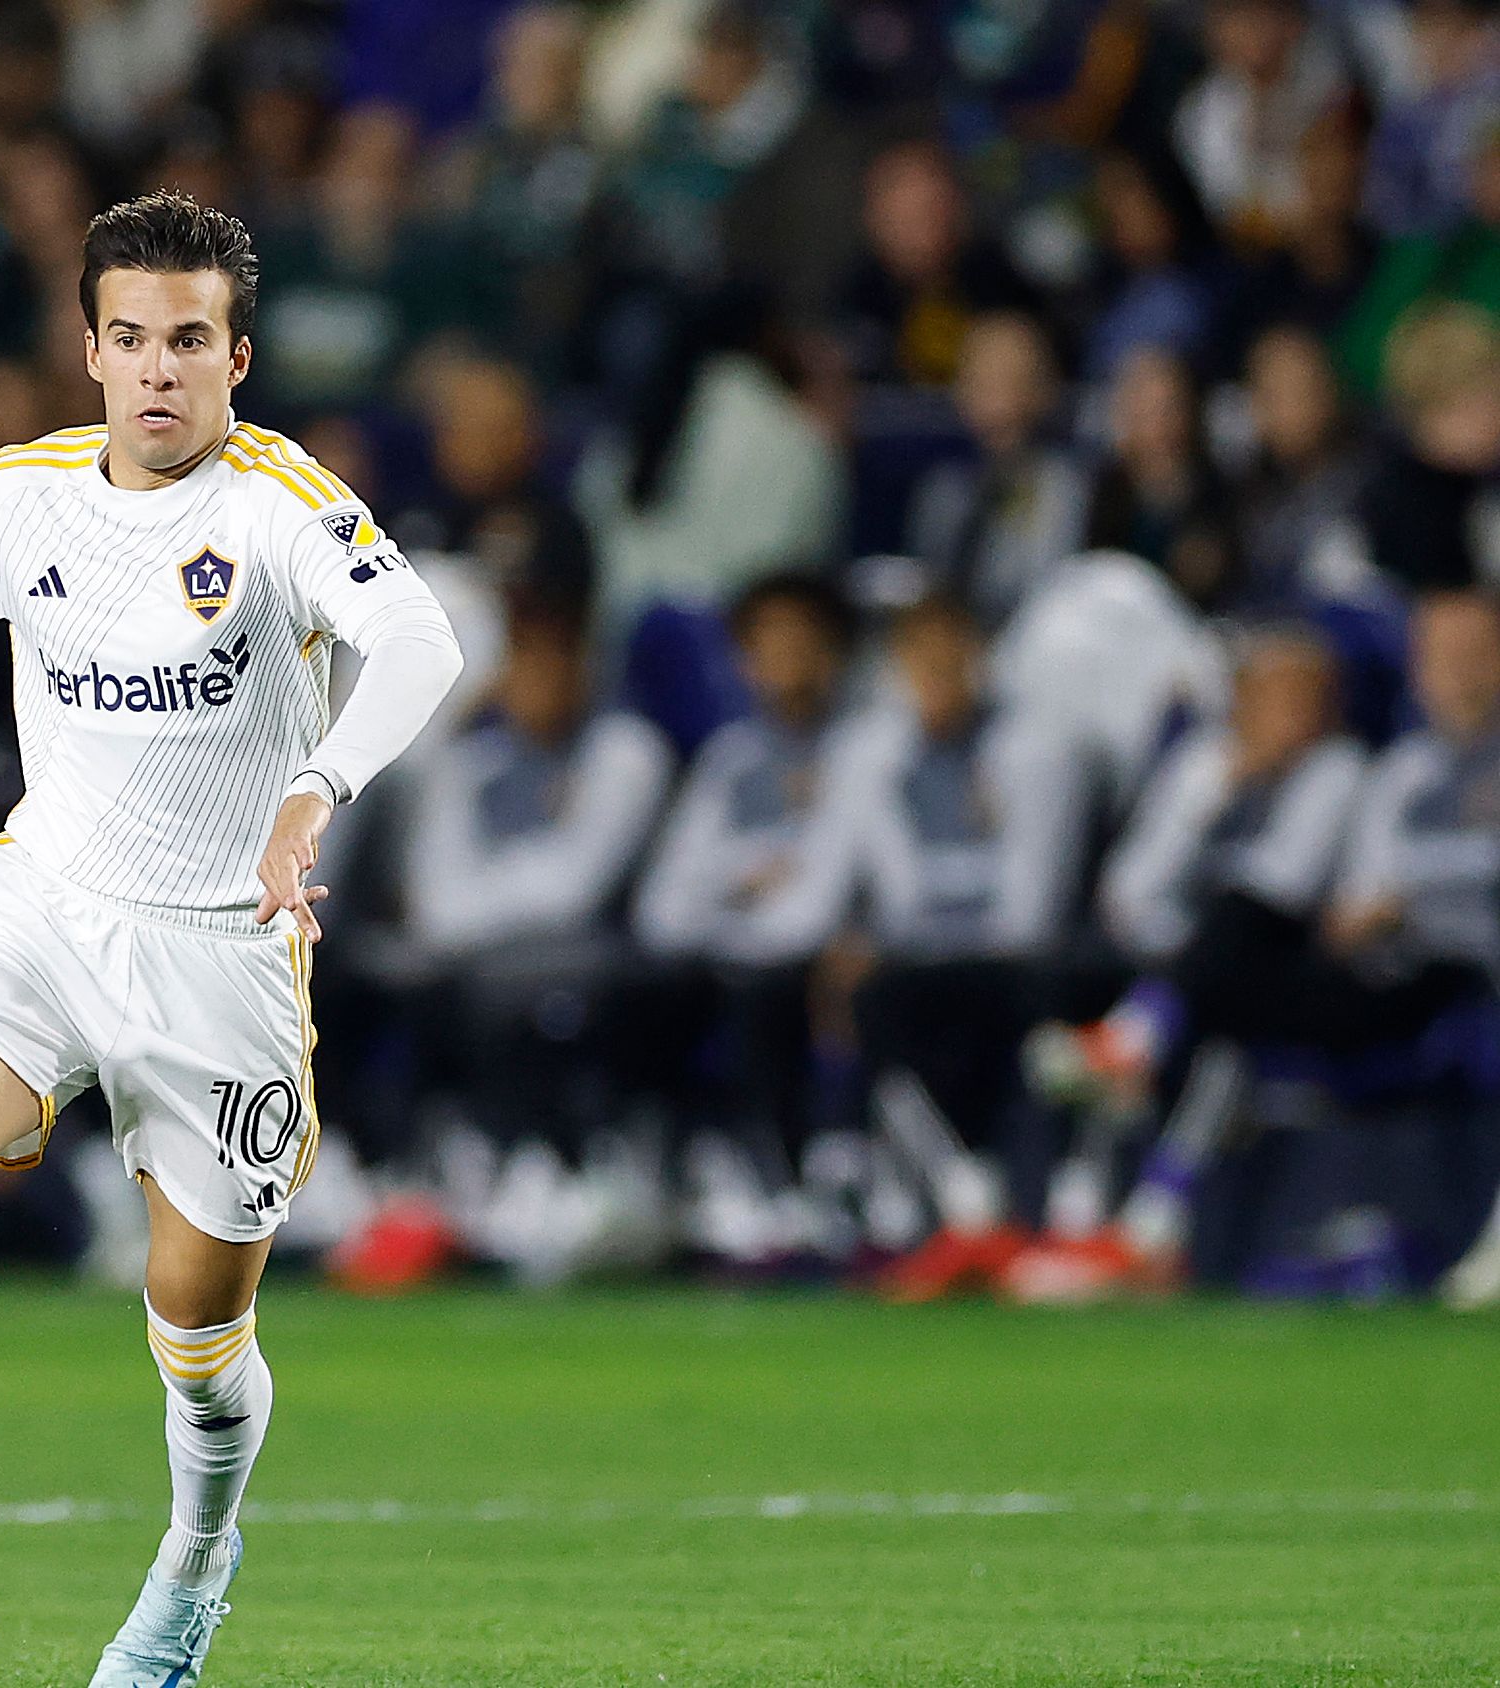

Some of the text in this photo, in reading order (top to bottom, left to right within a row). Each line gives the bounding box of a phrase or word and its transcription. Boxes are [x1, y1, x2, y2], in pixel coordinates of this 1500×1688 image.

[328, 515, 355, 530] MLS
[191, 572, 227, 595] LA
[38, 647, 235, 712] Herbalife
[210, 1075, 303, 1169] 10
